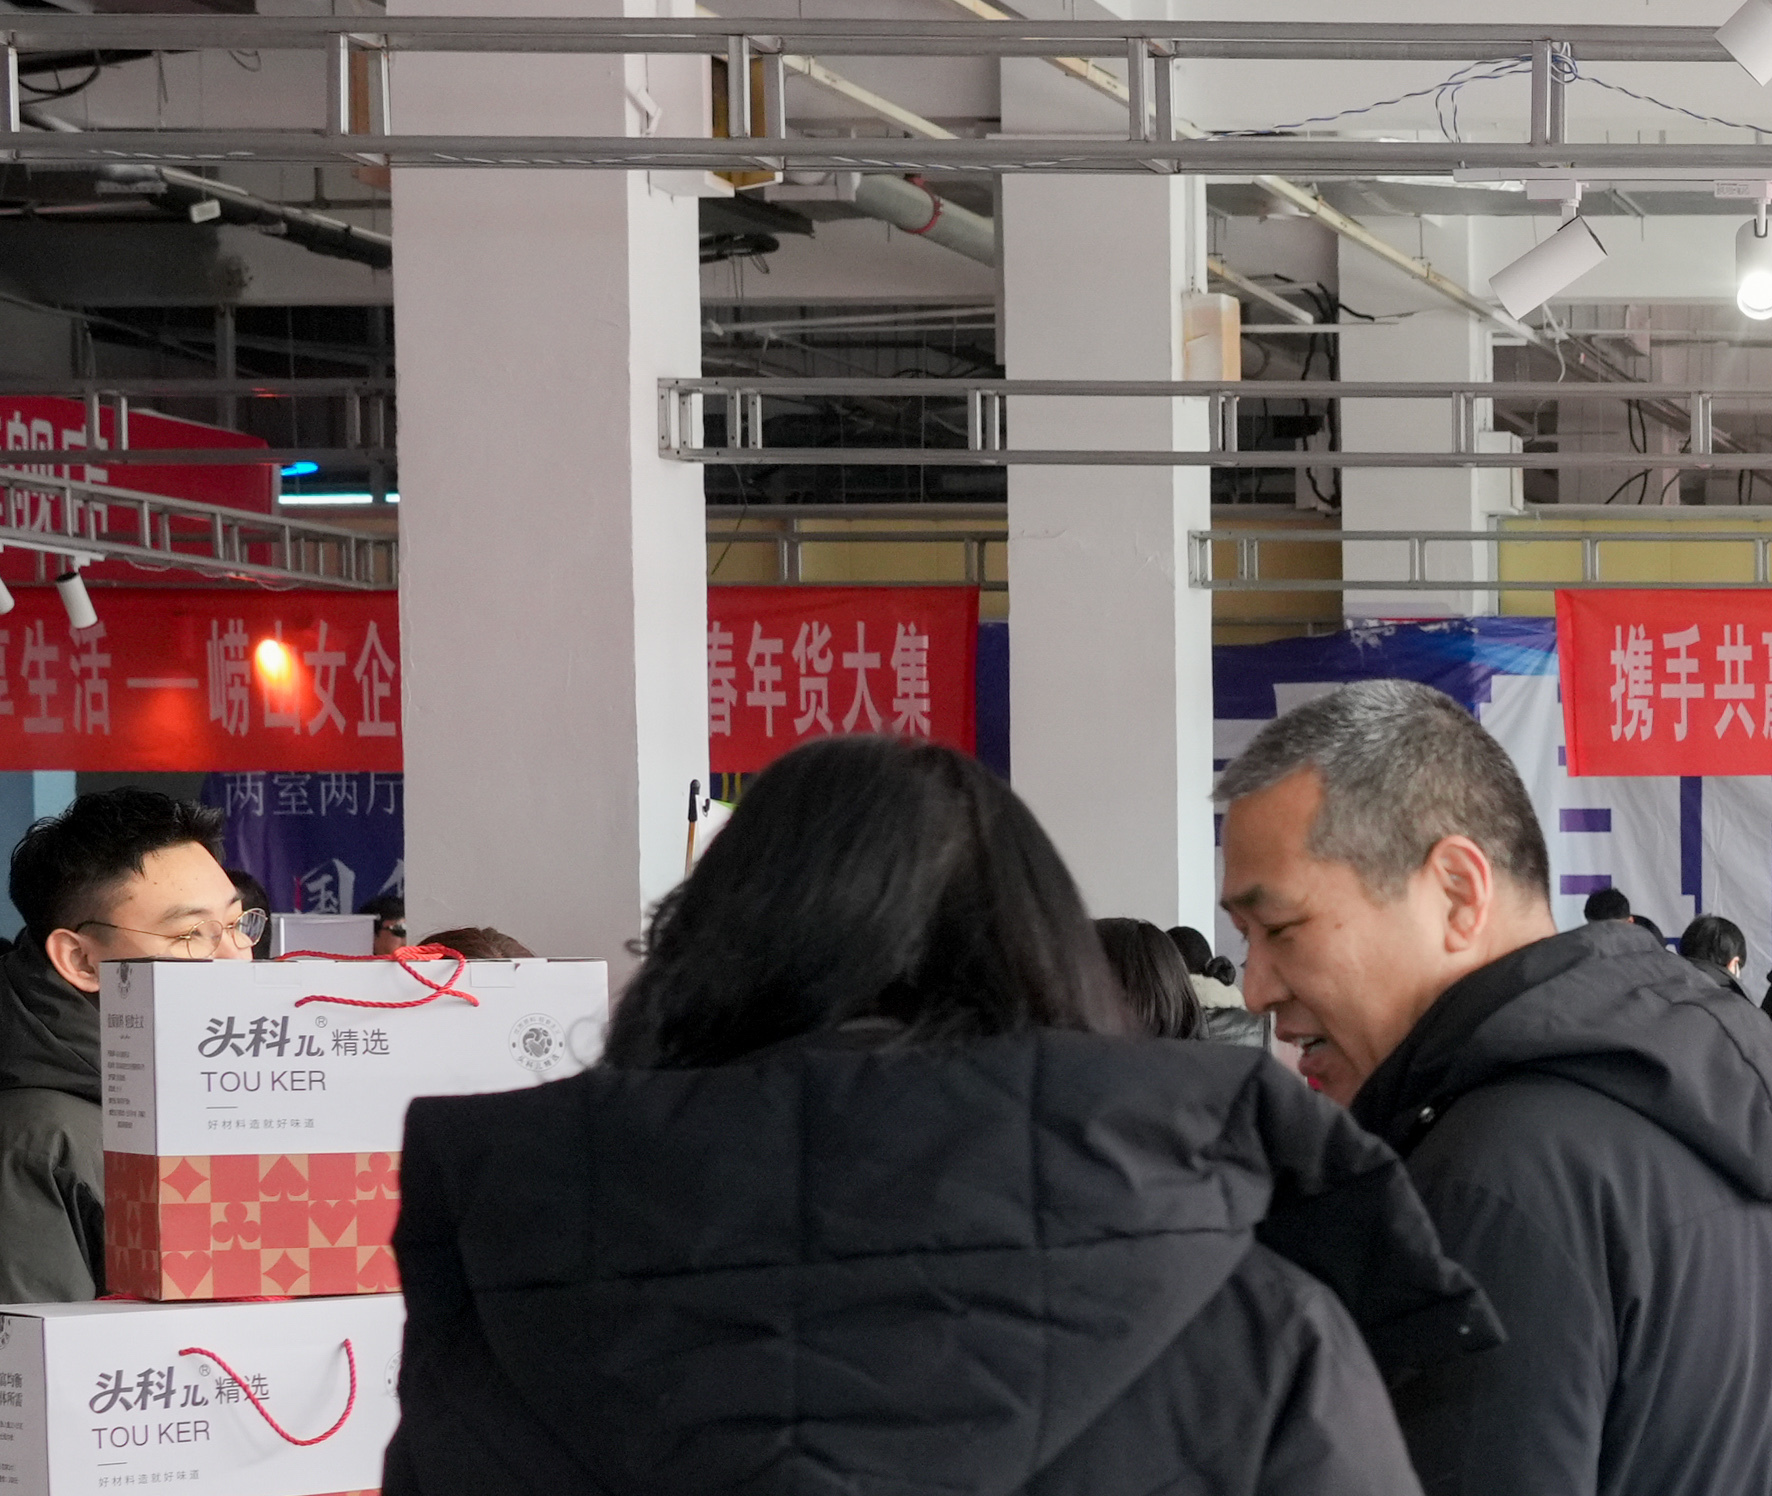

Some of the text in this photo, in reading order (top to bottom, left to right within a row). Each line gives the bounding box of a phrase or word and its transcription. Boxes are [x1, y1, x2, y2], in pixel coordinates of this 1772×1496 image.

[331, 1028, 391, 1057] 精选
[200, 1070, 327, 1093] TOU KER
[207, 1118, 316, 1131] 好材料造就好味道
[214, 1373, 271, 1406] 精选
[92, 1420, 210, 1450] TOU KER
[98, 1469, 200, 1488] 好材料造就好味道
